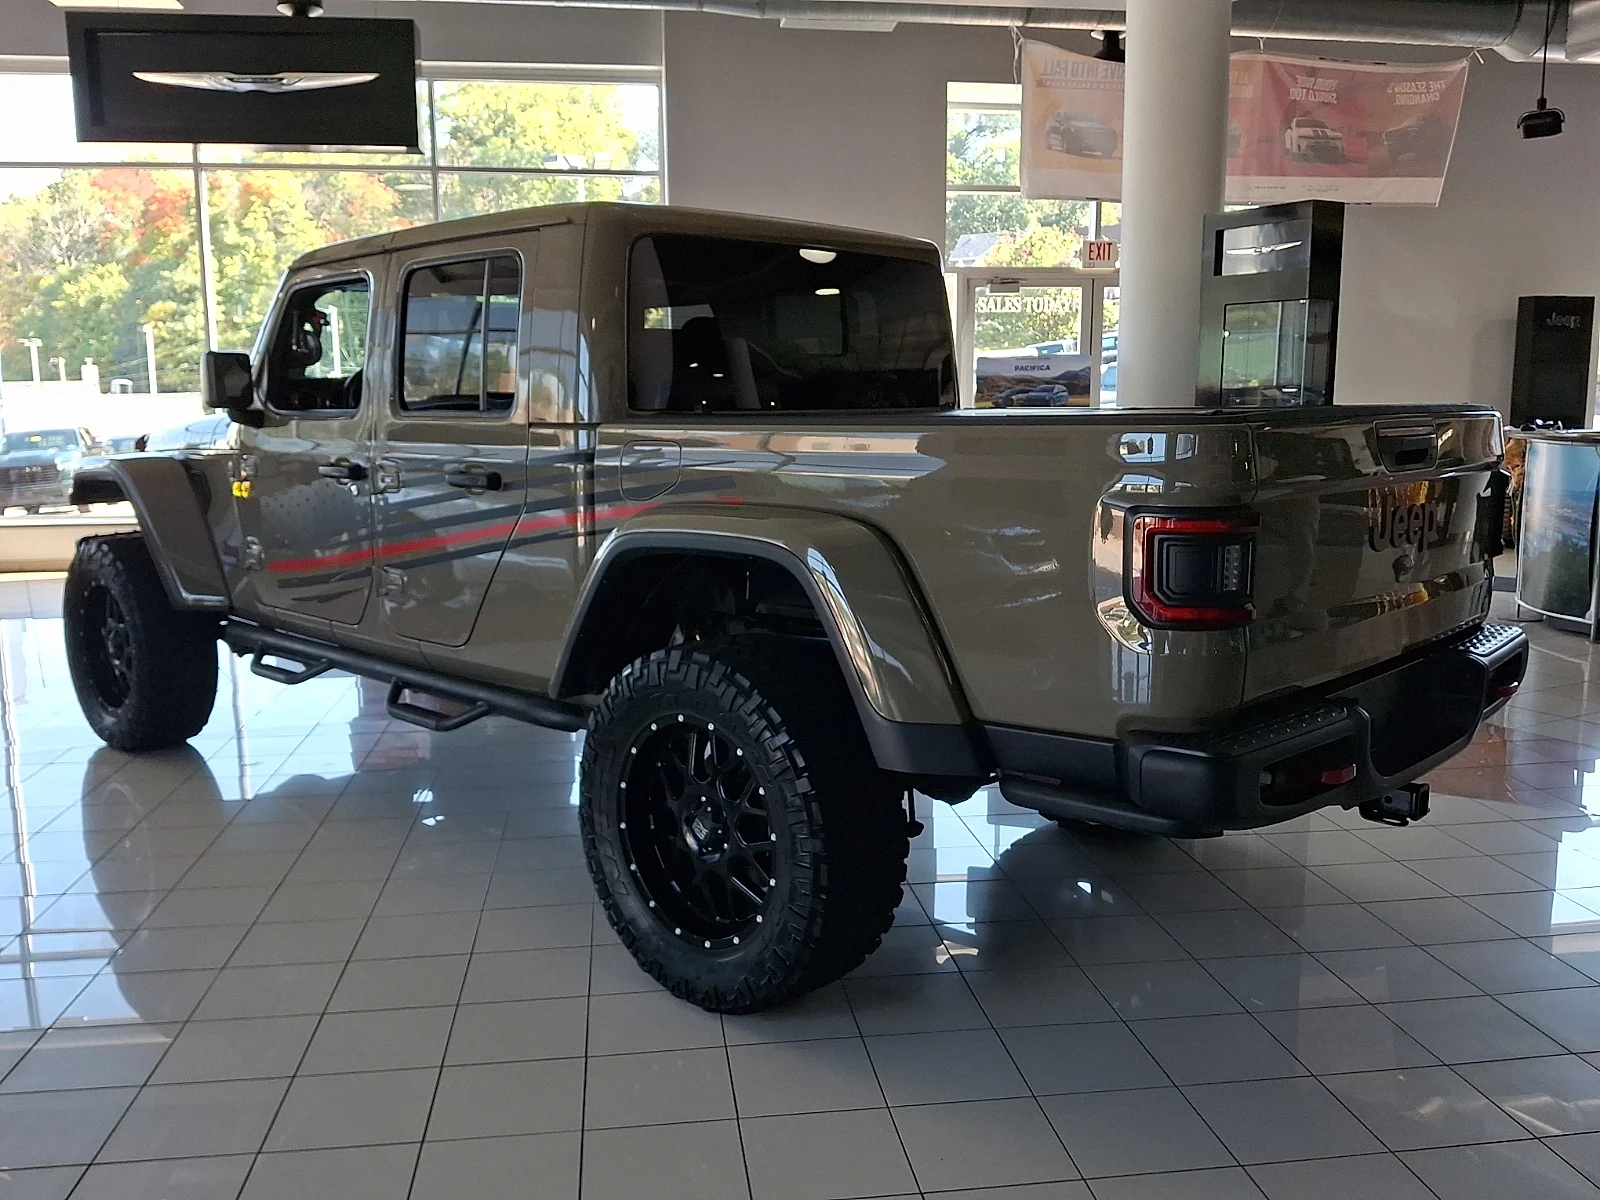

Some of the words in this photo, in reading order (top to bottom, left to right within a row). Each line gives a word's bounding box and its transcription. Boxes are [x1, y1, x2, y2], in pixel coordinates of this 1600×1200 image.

[1088, 242, 1113, 261] EXIT
[977, 296, 1022, 313] SALES
[1546, 311, 1581, 329] Jeep
[1014, 364, 1051, 372] PACIFICA
[1368, 494, 1440, 553] Jeep
